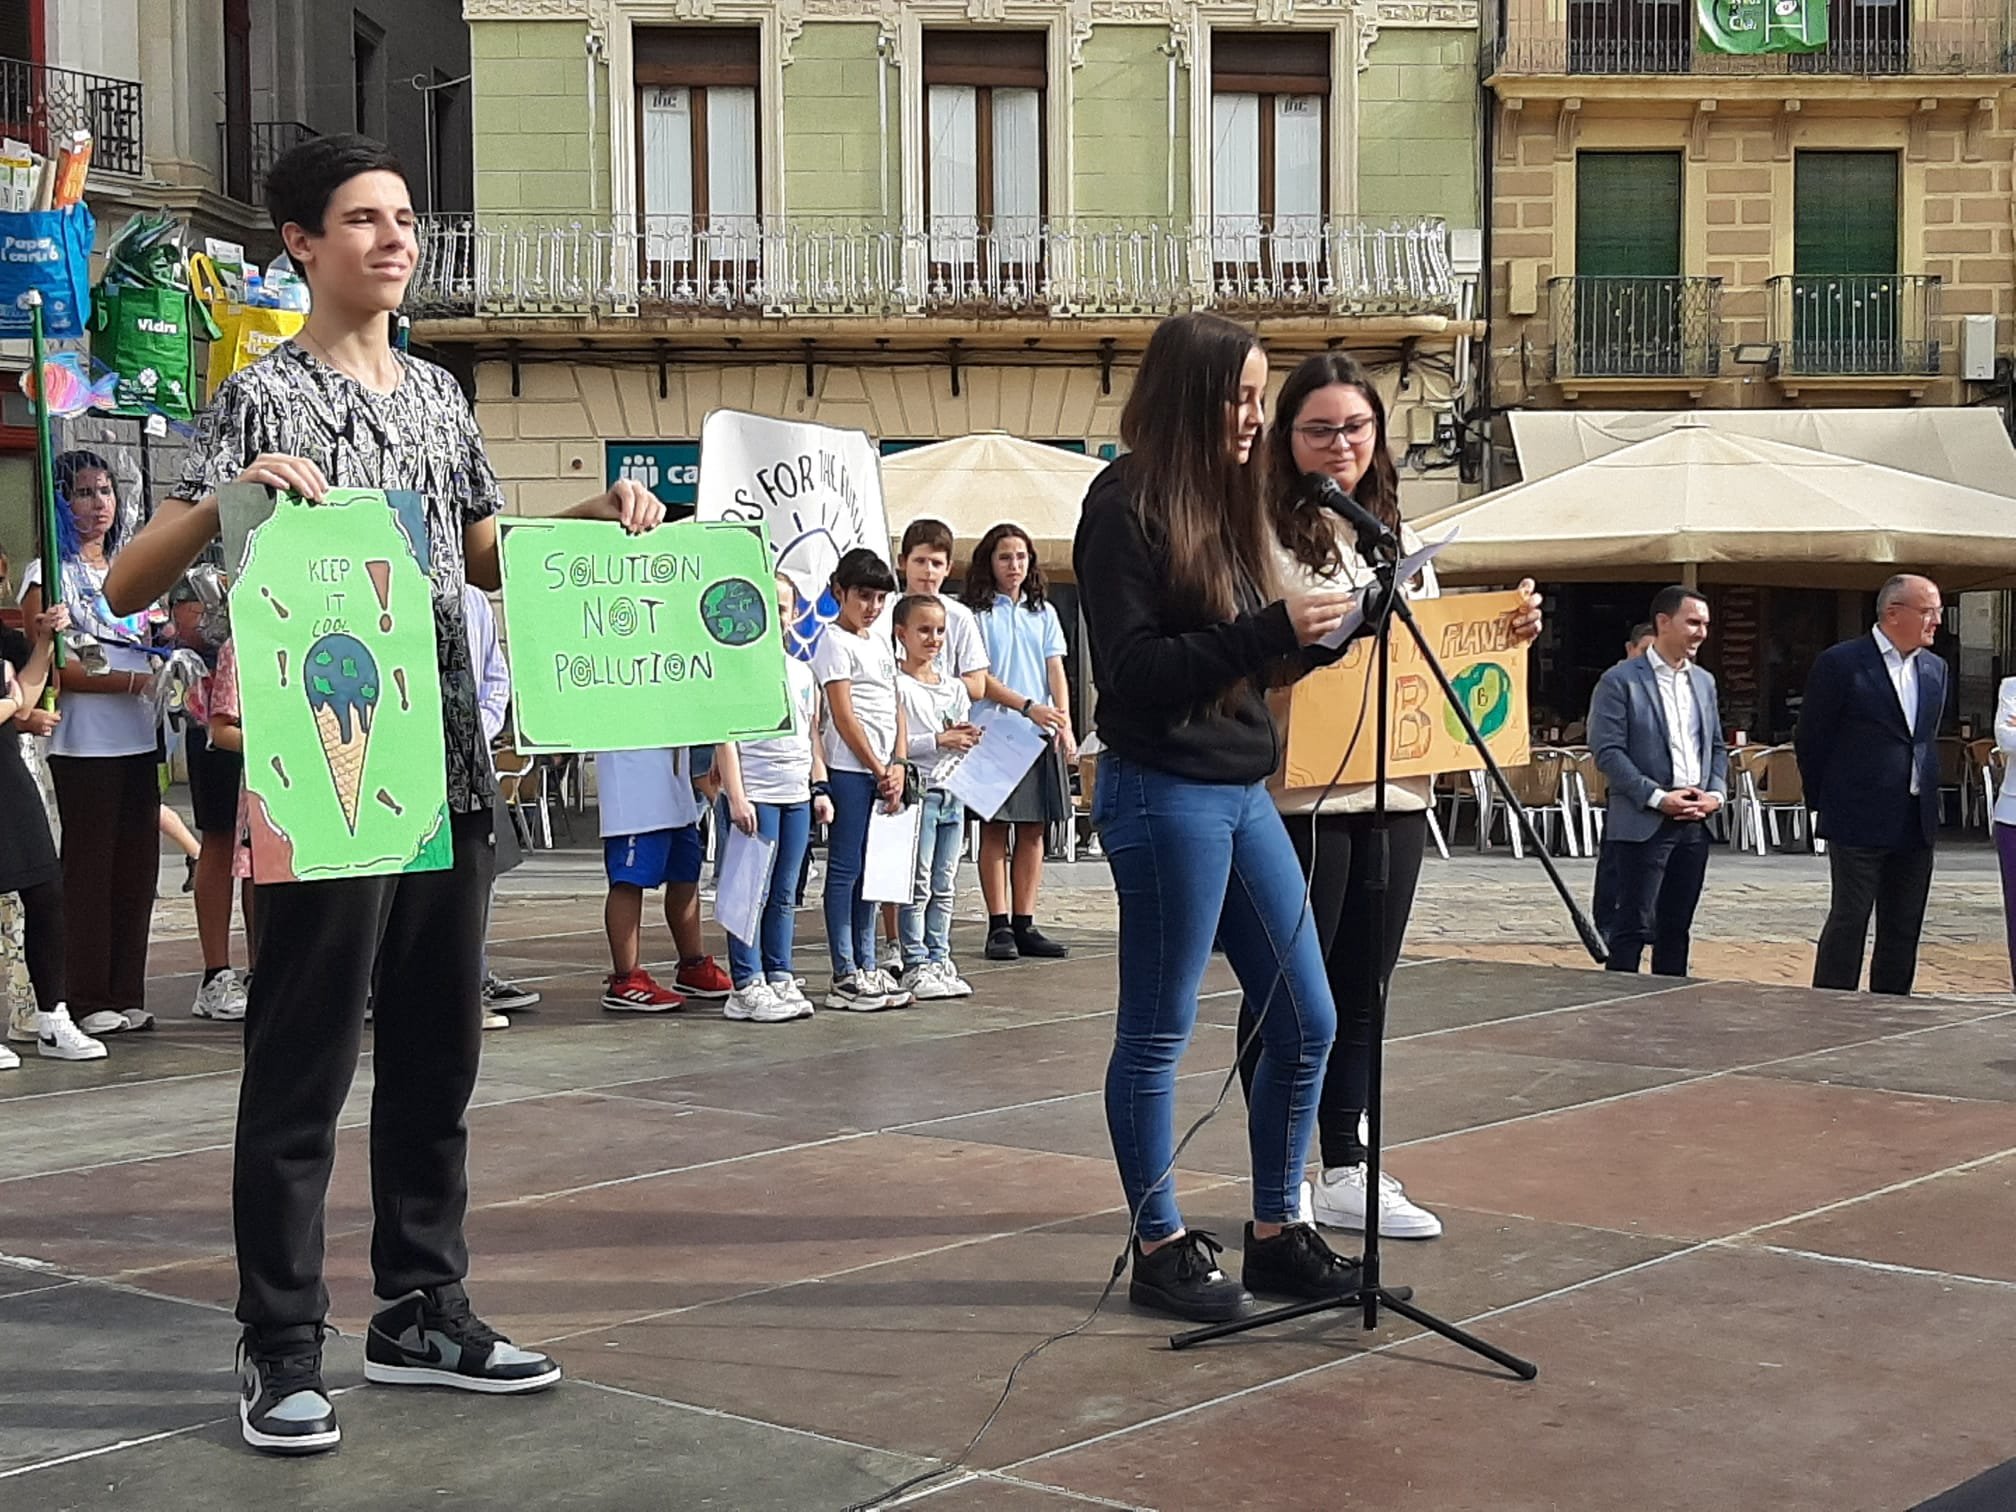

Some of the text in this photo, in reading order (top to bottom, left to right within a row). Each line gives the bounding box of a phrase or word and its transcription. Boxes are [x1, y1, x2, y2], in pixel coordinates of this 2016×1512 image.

[757, 454, 814, 506] FOR
[819, 449, 838, 493] THE
[308, 558, 350, 582] KEEP
[545, 552, 701, 589] SOLUTION
[325, 593, 345, 612] IT
[583, 596, 665, 639] NOT
[311, 617, 350, 638] COOL
[555, 651, 712, 692] POLLUTION
[1391, 674, 1432, 762] B
